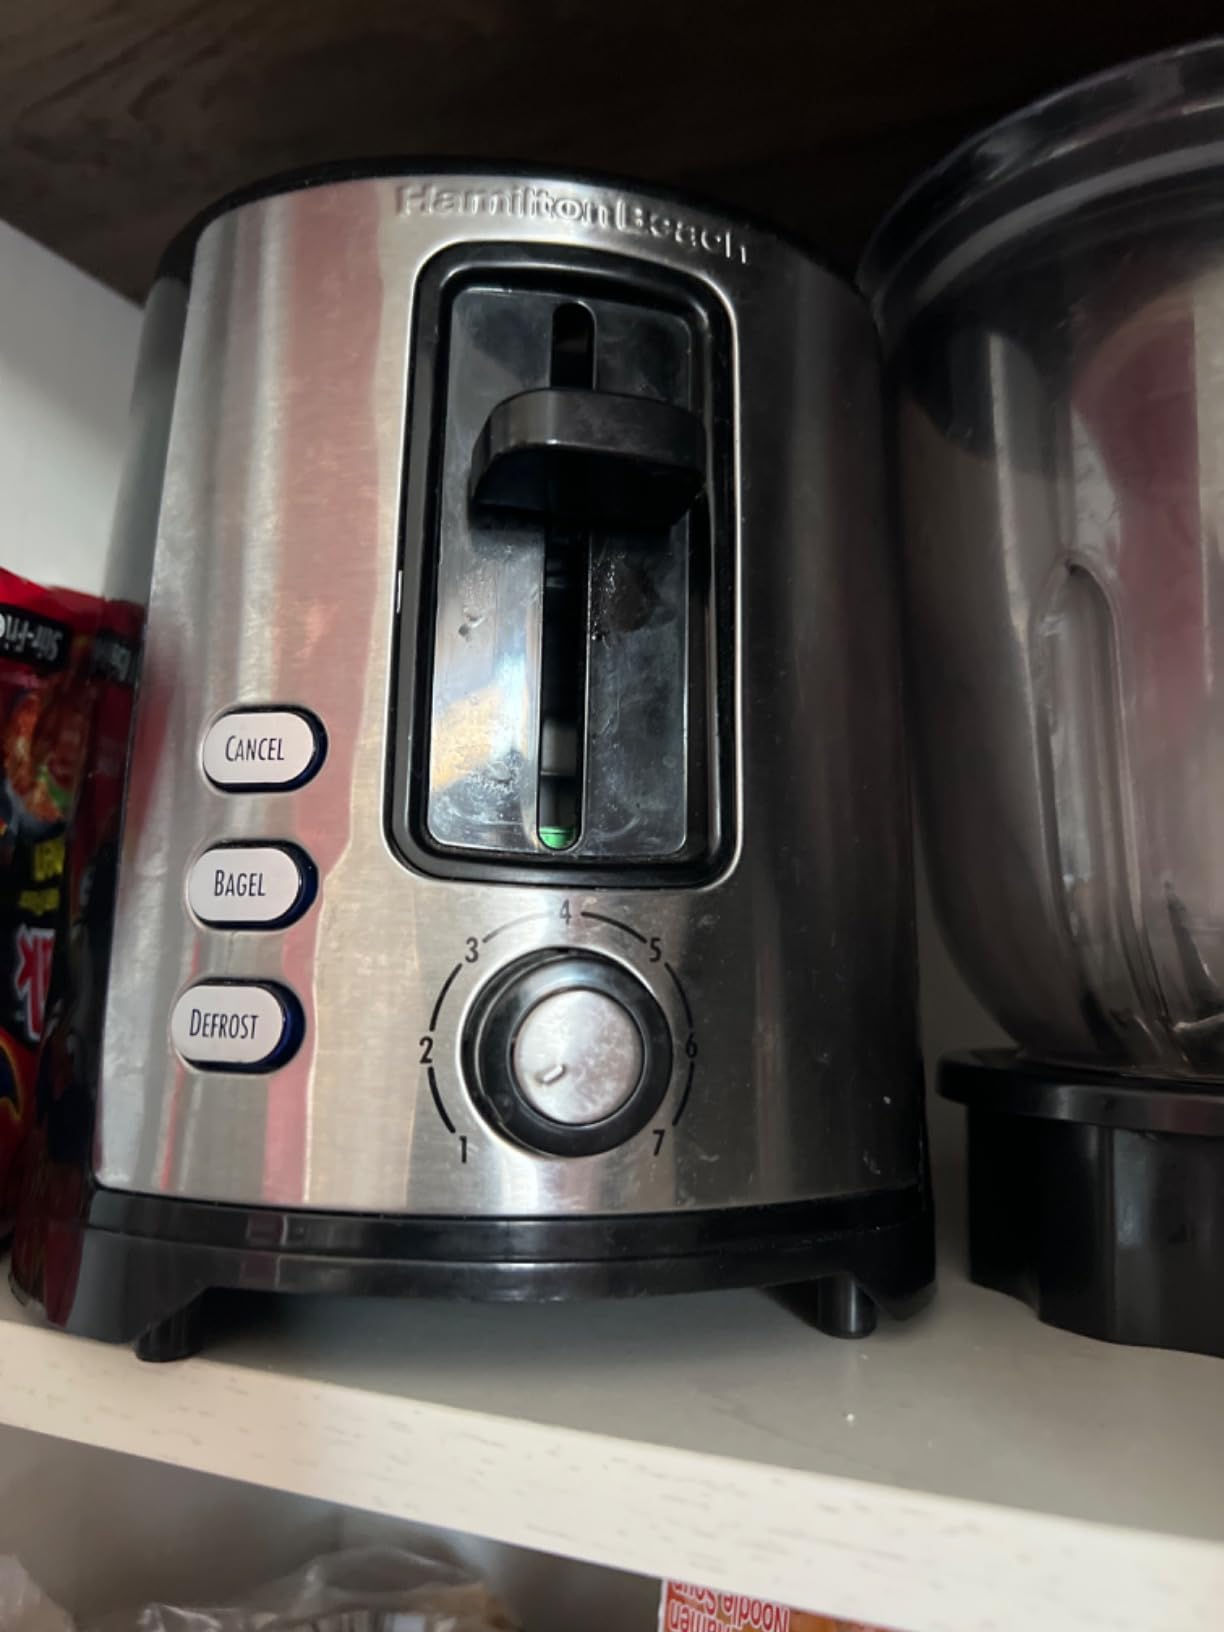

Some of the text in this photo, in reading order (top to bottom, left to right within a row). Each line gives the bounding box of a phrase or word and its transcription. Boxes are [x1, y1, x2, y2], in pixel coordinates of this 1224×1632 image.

[393, 184, 610, 229] Hamilton
[0, 612, 63, 661] Stir-Fri
[225, 735, 285, 762] CANCEL
[214, 869, 266, 897] BAGEL
[559, 899, 572, 925] 4
[465, 937, 479, 963] 3
[649, 937, 662, 963] 5
[189, 1008, 259, 1039] DEFROST
[419, 1036, 434, 1064] 2
[685, 1034, 698, 1059] 6
[459, 1136, 468, 1164] 1
[652, 1129, 665, 1156] 7
[669, 1602, 732, 1632] amen
